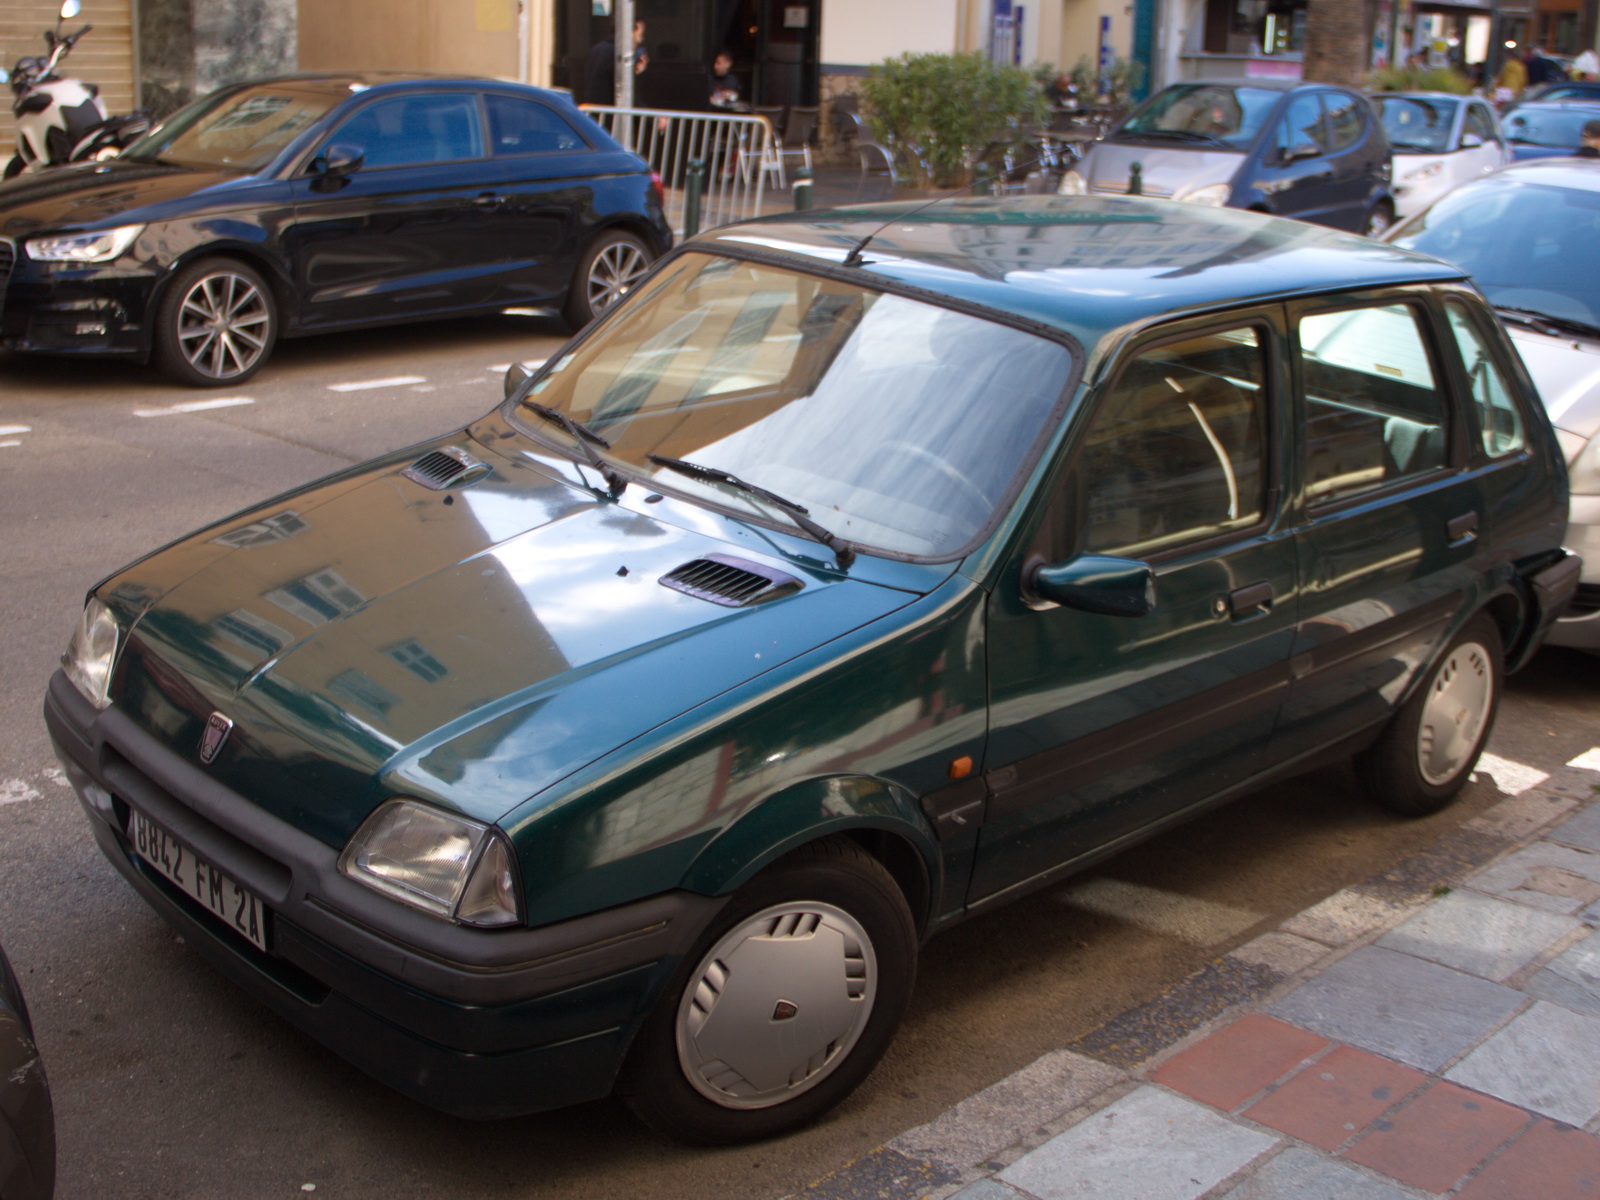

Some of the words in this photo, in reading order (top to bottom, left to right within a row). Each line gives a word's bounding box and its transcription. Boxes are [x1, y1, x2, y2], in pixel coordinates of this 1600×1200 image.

[137, 813, 184, 884] 8842
[195, 856, 225, 916] FM
[234, 883, 260, 943] 2A
